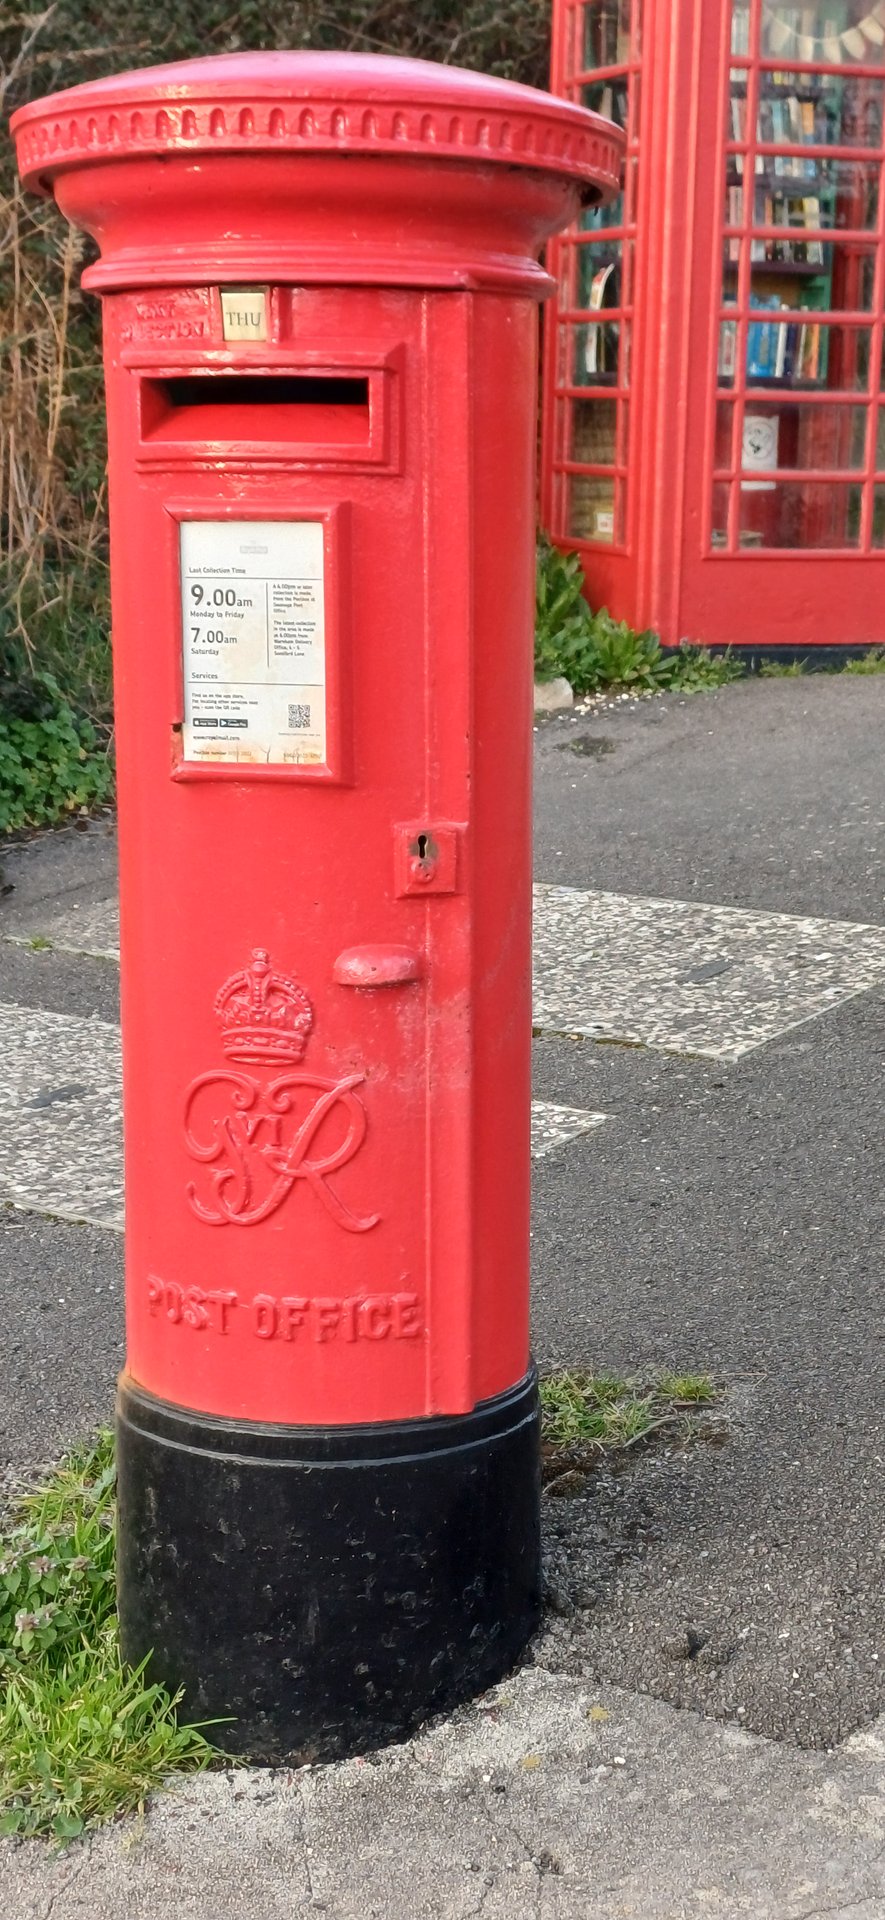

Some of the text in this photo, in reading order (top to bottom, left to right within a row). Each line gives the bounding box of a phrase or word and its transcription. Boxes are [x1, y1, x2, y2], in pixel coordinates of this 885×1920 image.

[225, 311, 262, 327] THU
[191, 584, 253, 607] 9.00am
[190, 610, 215, 619] Monday
[225, 611, 245, 619] Friday
[190, 627, 238, 644] 7.00am
[191, 648, 219, 656] Saturday
[145, 1273, 426, 1344] POST OFFICE
